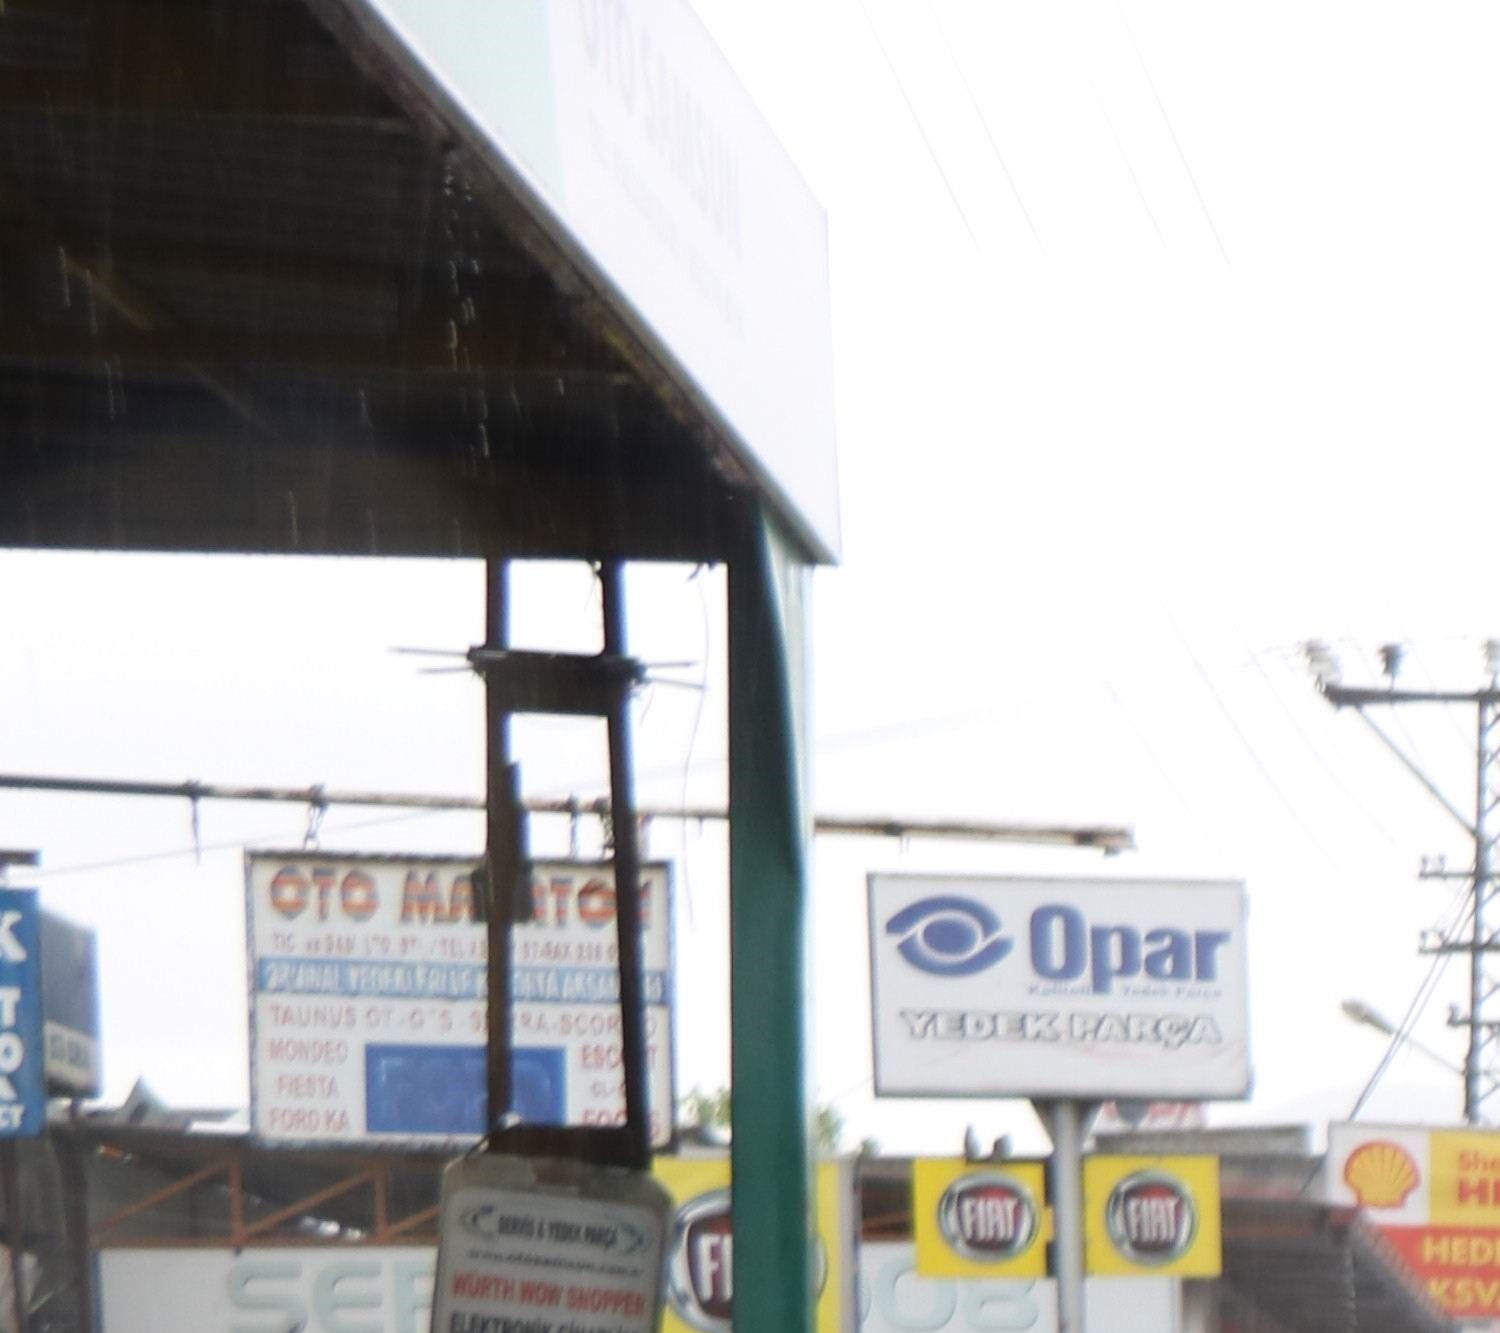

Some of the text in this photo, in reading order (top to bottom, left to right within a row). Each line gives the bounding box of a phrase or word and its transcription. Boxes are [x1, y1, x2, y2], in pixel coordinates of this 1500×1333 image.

[268, 866, 379, 921] OTO
[1029, 903, 1231, 995] Opar
[899, 1009, 1223, 1050] YEDEK PARÇA
[268, 1039, 348, 1065] MONDEO
[276, 1075, 338, 1098] FIESTA
[961, 1198, 1017, 1241] FIAT
[1126, 1197, 1180, 1242] FIAT
